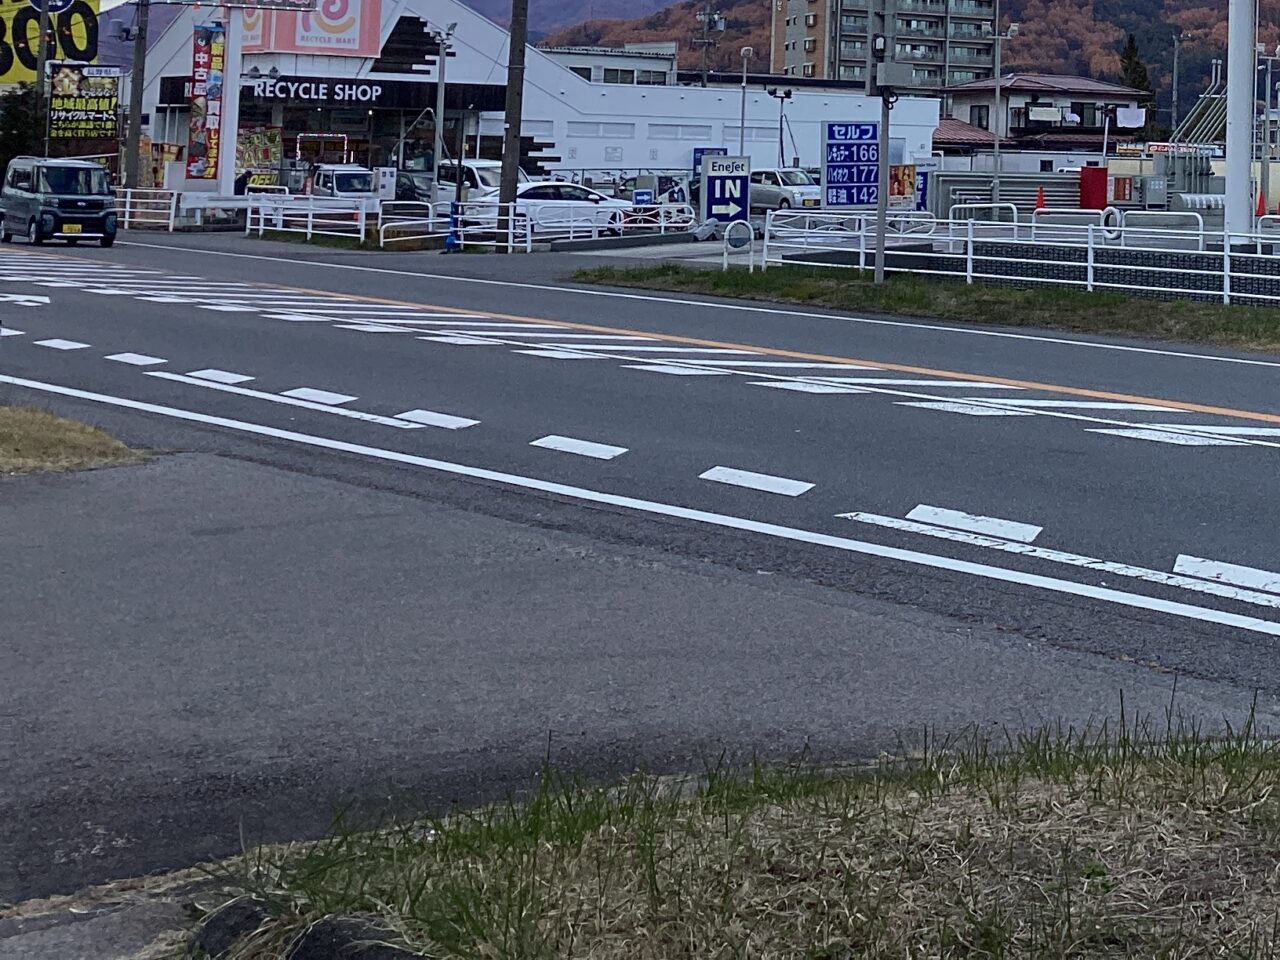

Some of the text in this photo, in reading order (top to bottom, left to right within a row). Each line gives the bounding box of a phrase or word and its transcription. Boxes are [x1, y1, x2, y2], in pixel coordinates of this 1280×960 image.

[300, 35, 356, 45] RECYCLE MART
[193, 51, 208, 96] 中古品
[254, 81, 382, 101] RECYCLE SHOP
[832, 124, 873, 139] セルフ
[851, 145, 878, 162] 166
[827, 166, 878, 183] ハイオク 177
[714, 179, 741, 198] IN
[827, 188, 848, 203] 軽油
[851, 187, 878, 203] 142
